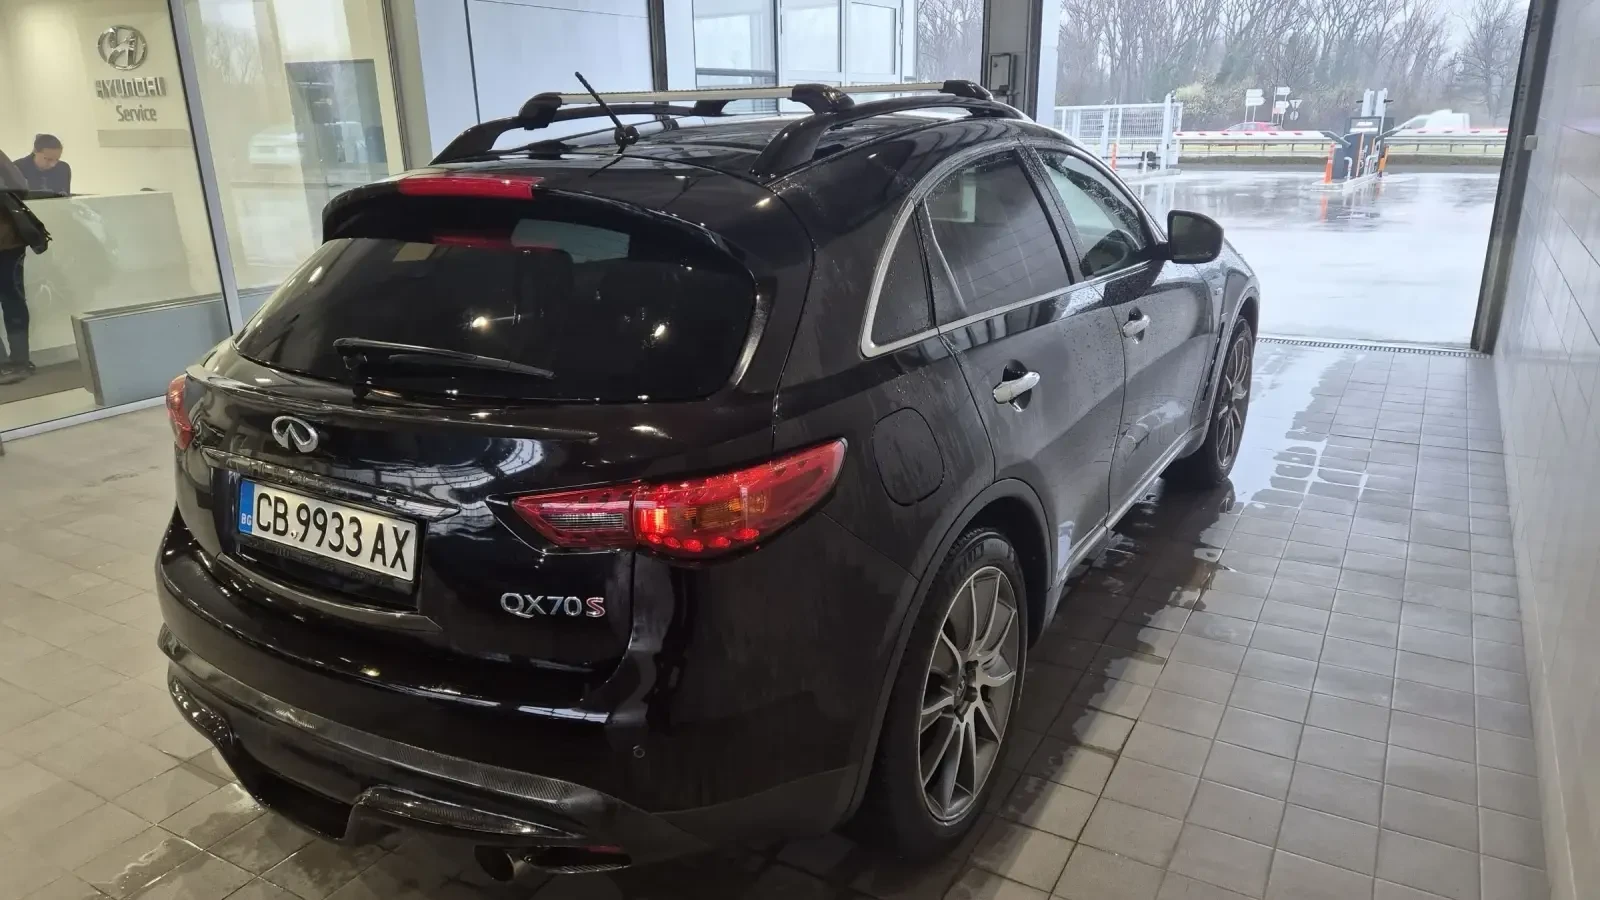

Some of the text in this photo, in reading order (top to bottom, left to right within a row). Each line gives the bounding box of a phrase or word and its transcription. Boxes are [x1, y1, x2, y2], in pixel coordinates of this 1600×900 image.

[95, 77, 167, 99] HYUNDAI
[115, 104, 157, 122] Service
[241, 513, 252, 526] BG
[256, 492, 289, 537] CB
[296, 503, 363, 558] 9933
[370, 523, 410, 572] AX
